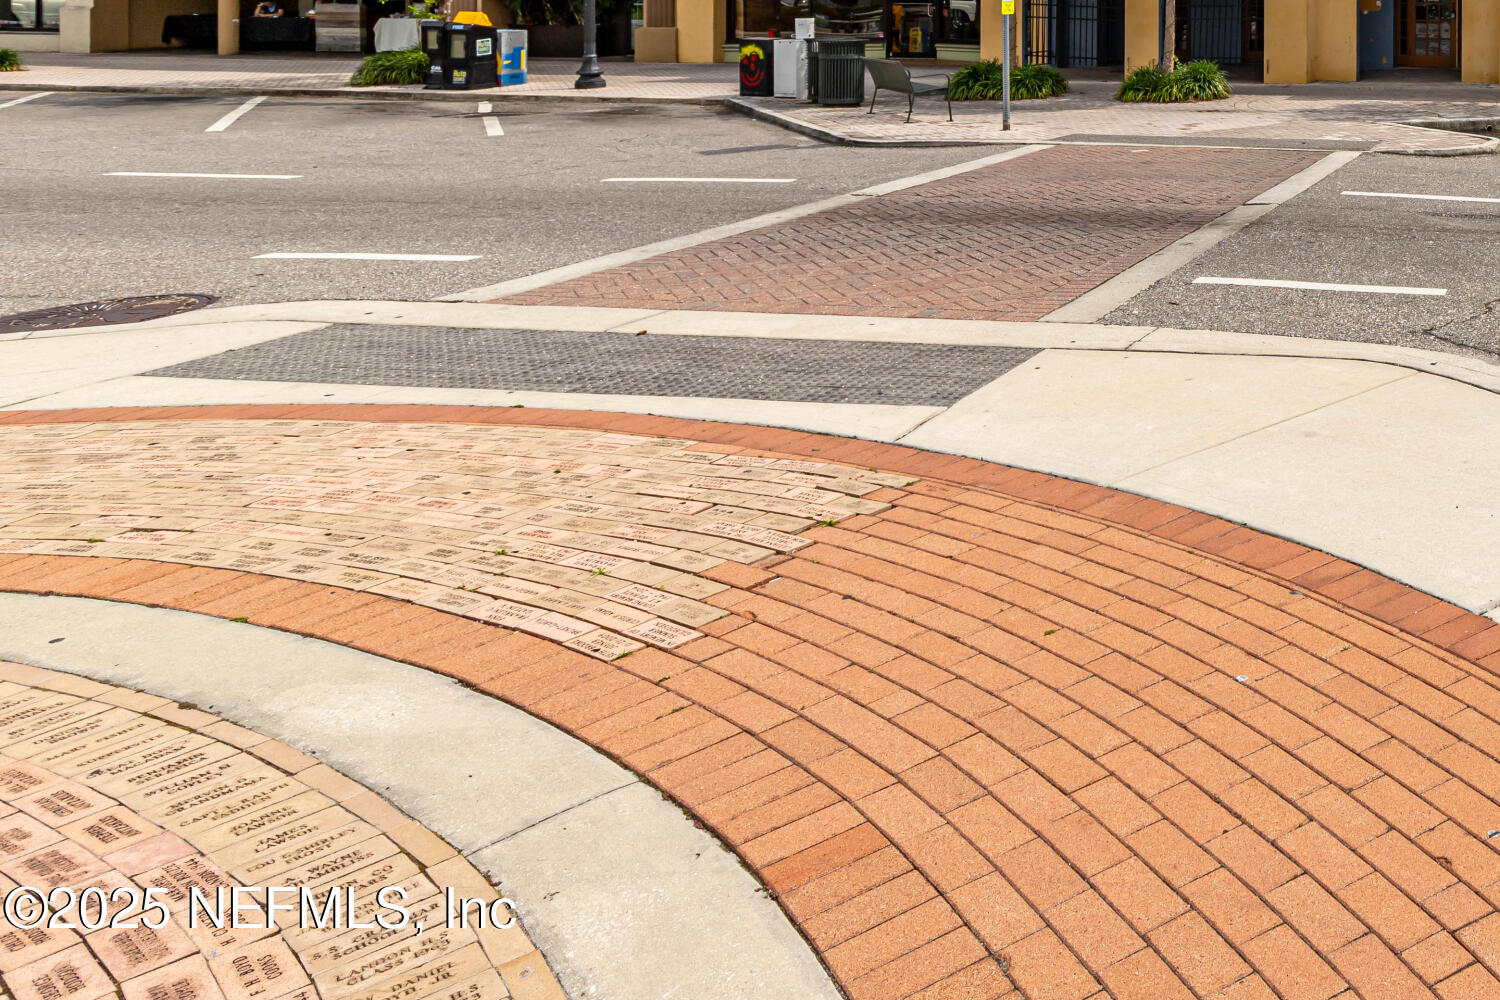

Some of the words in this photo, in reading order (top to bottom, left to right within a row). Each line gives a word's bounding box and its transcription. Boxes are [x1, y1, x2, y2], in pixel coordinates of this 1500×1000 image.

[127, 752, 205, 783] BENJAMIN
[143, 770, 213, 798] WILLIAM
[164, 776, 267, 817] GRANDMAMA
[167, 771, 223, 795] COPLEY
[167, 783, 229, 810] MERVIN
[240, 783, 290, 803] RALPH
[229, 806, 292, 833] JOANNE
[234, 809, 299, 837] LAWSON
[253, 826, 319, 854] LAWSON
[256, 823, 309, 847] JAMES
[285, 843, 332, 865] FROST
[307, 849, 363, 874] WAYNE
[284, 852, 374, 888] HAMBLISS
[232, 955, 255, 978] BOYD
[256, 954, 283, 980] COONS
[335, 946, 411, 983] LANDON
[346, 958, 404, 986] CLASS
[391, 961, 457, 993] DANIEL
